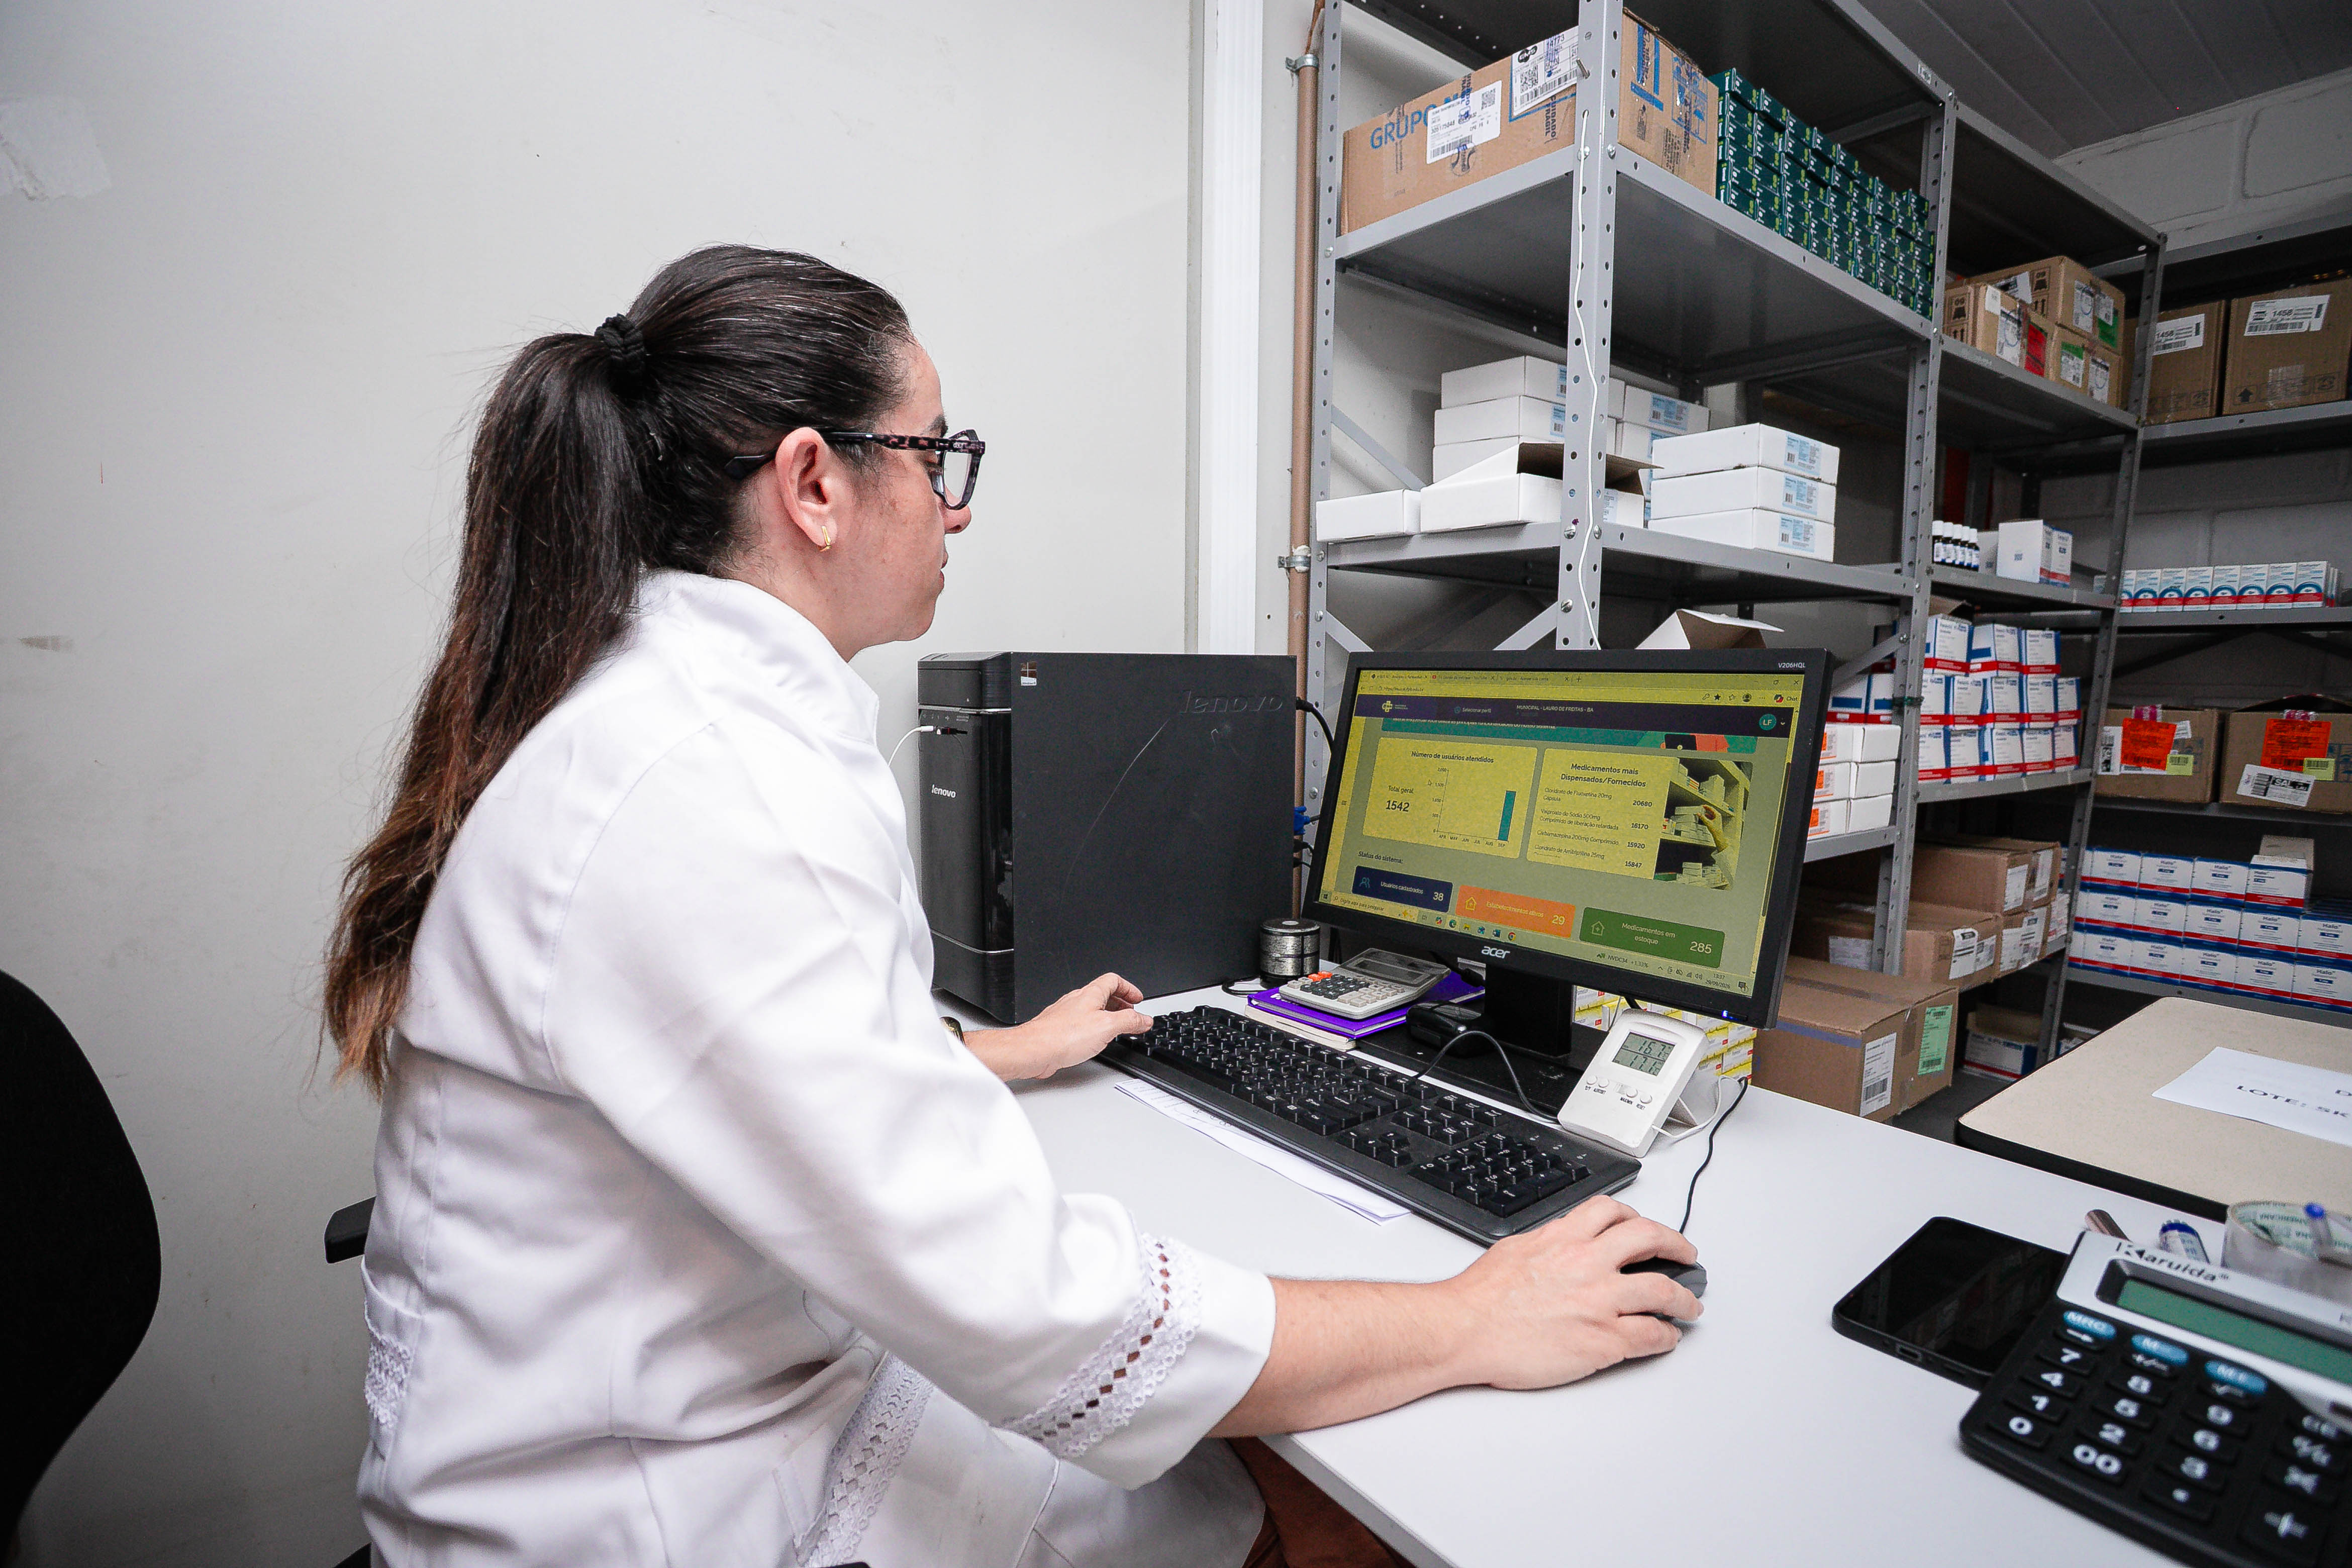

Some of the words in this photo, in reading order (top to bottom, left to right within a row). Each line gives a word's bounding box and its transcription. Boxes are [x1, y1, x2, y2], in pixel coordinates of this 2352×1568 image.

[1411, 750, 1432, 759] Número
[1465, 755, 1494, 763] atendidos
[1571, 763, 1620, 773] Medicamentos
[1561, 773, 1646, 788] Dispensados/Fornecidos
[931, 784, 956, 798] lenovo
[1386, 800, 1410, 812] 1542
[1539, 816, 1566, 825] Comprimido
[1537, 830, 1571, 839] Carbamazepina
[1572, 834, 1589, 842] 200mg
[1590, 837, 1619, 845] Comprimido
[1358, 851, 1374, 859] Status
[1382, 855, 1404, 864] sistema:
[1399, 884, 1423, 894] cadastrados
[1433, 892, 1443, 901] 38
[1486, 901, 1528, 916] Estabelecimentos
[1528, 910, 1544, 918] ativos
[1552, 915, 1565, 925] 29
[1622, 922, 1663, 937] Medicamentos
[1634, 934, 1658, 945] estoque
[1481, 946, 1510, 959] acer
[1690, 941, 1712, 954] 285
[1608, 955, 1628, 963] NVDC34
[1705, 979, 1731, 989] 29/09/2026
[1638, 1040, 1666, 1057] 16.7
[2236, 1085, 2307, 1107] LOTE:
[2061, 1347, 2082, 1363] 7
[2041, 1372, 2065, 1387] 4
[2031, 1395, 2049, 1411] 1
[2009, 1416, 2033, 1435] 0
[2073, 1444, 2122, 1475] 00
